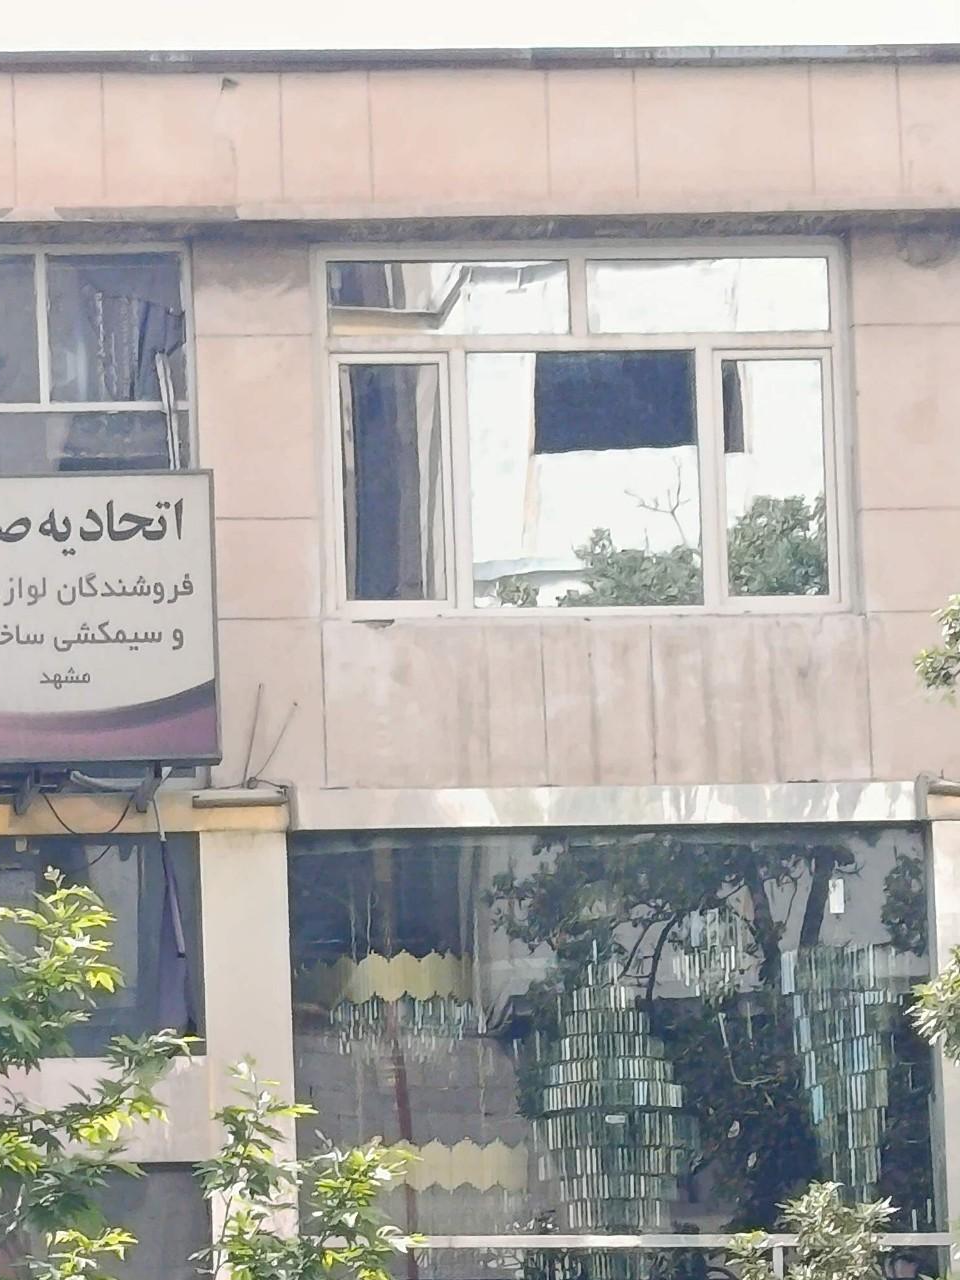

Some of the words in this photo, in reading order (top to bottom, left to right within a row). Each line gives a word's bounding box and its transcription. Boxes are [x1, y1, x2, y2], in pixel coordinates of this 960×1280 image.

[38, 498, 183, 556] اتحادیه
[57, 573, 194, 606] فروشندگان
[53, 620, 162, 652] سیمکشی
[171, 627, 185, 650] و
[39, 667, 90, 689] مشهد
